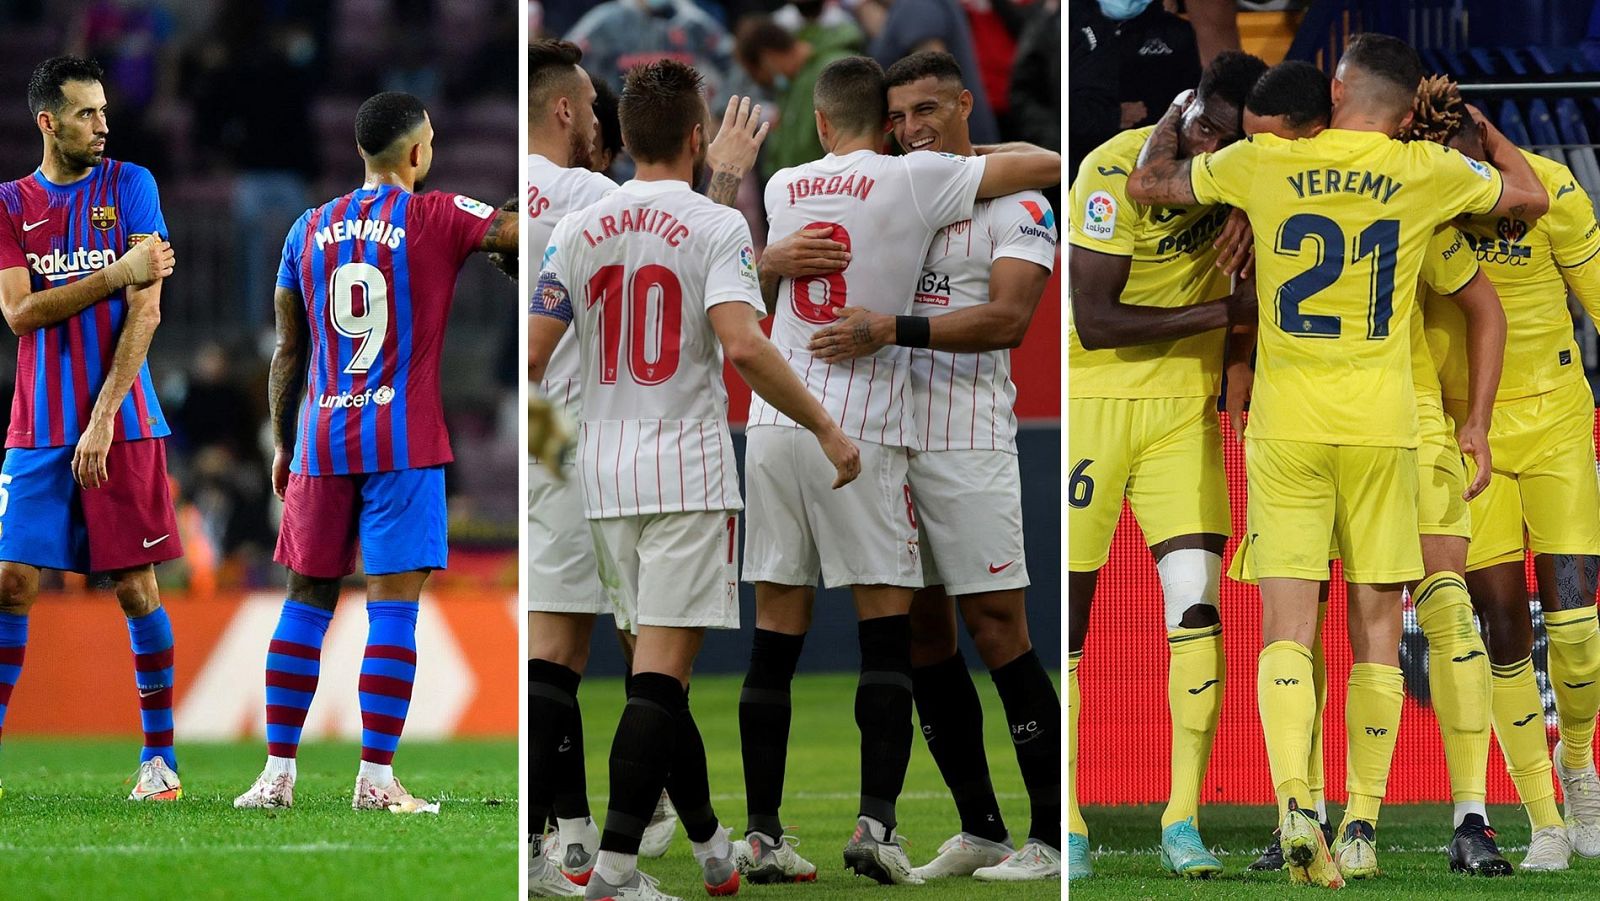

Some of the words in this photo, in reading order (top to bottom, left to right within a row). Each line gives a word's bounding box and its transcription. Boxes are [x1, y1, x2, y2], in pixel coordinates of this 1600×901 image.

[787, 170, 875, 206] JORDÁN
[1286, 169, 1403, 205] YEREMY
[314, 219, 406, 250] MEMPHIS
[582, 208, 690, 248] I.RAKITIC
[1086, 222, 1111, 235] LaLiga
[27, 246, 118, 276] Rakuten
[791, 221, 852, 325] 8
[1274, 213, 1401, 341] 21
[330, 262, 389, 374] 9
[584, 264, 683, 387] 10
[319, 391, 372, 408] unicef
[1069, 458, 1095, 509] 6
